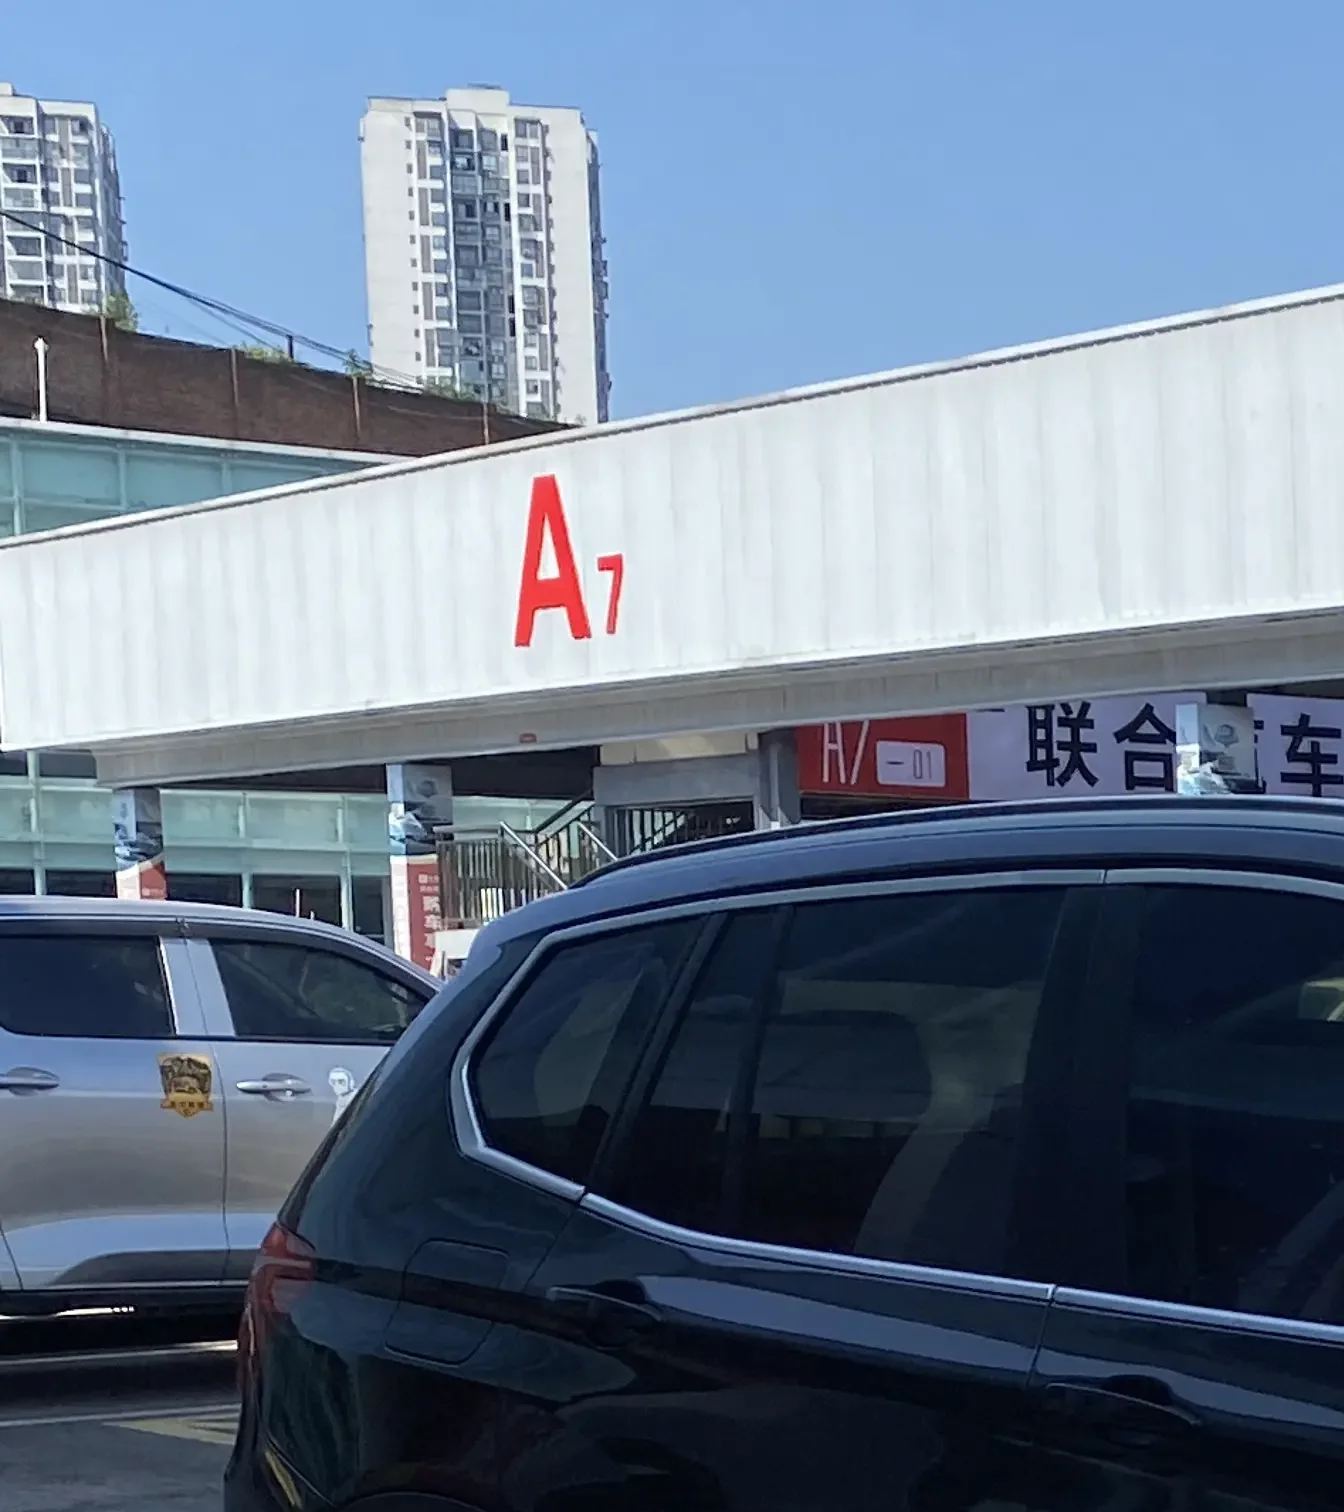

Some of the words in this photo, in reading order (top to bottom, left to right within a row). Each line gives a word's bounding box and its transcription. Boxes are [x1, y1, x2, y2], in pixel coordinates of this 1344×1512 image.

[514, 473, 625, 647] A7
[1025, 700, 1344, 797] 联合车
